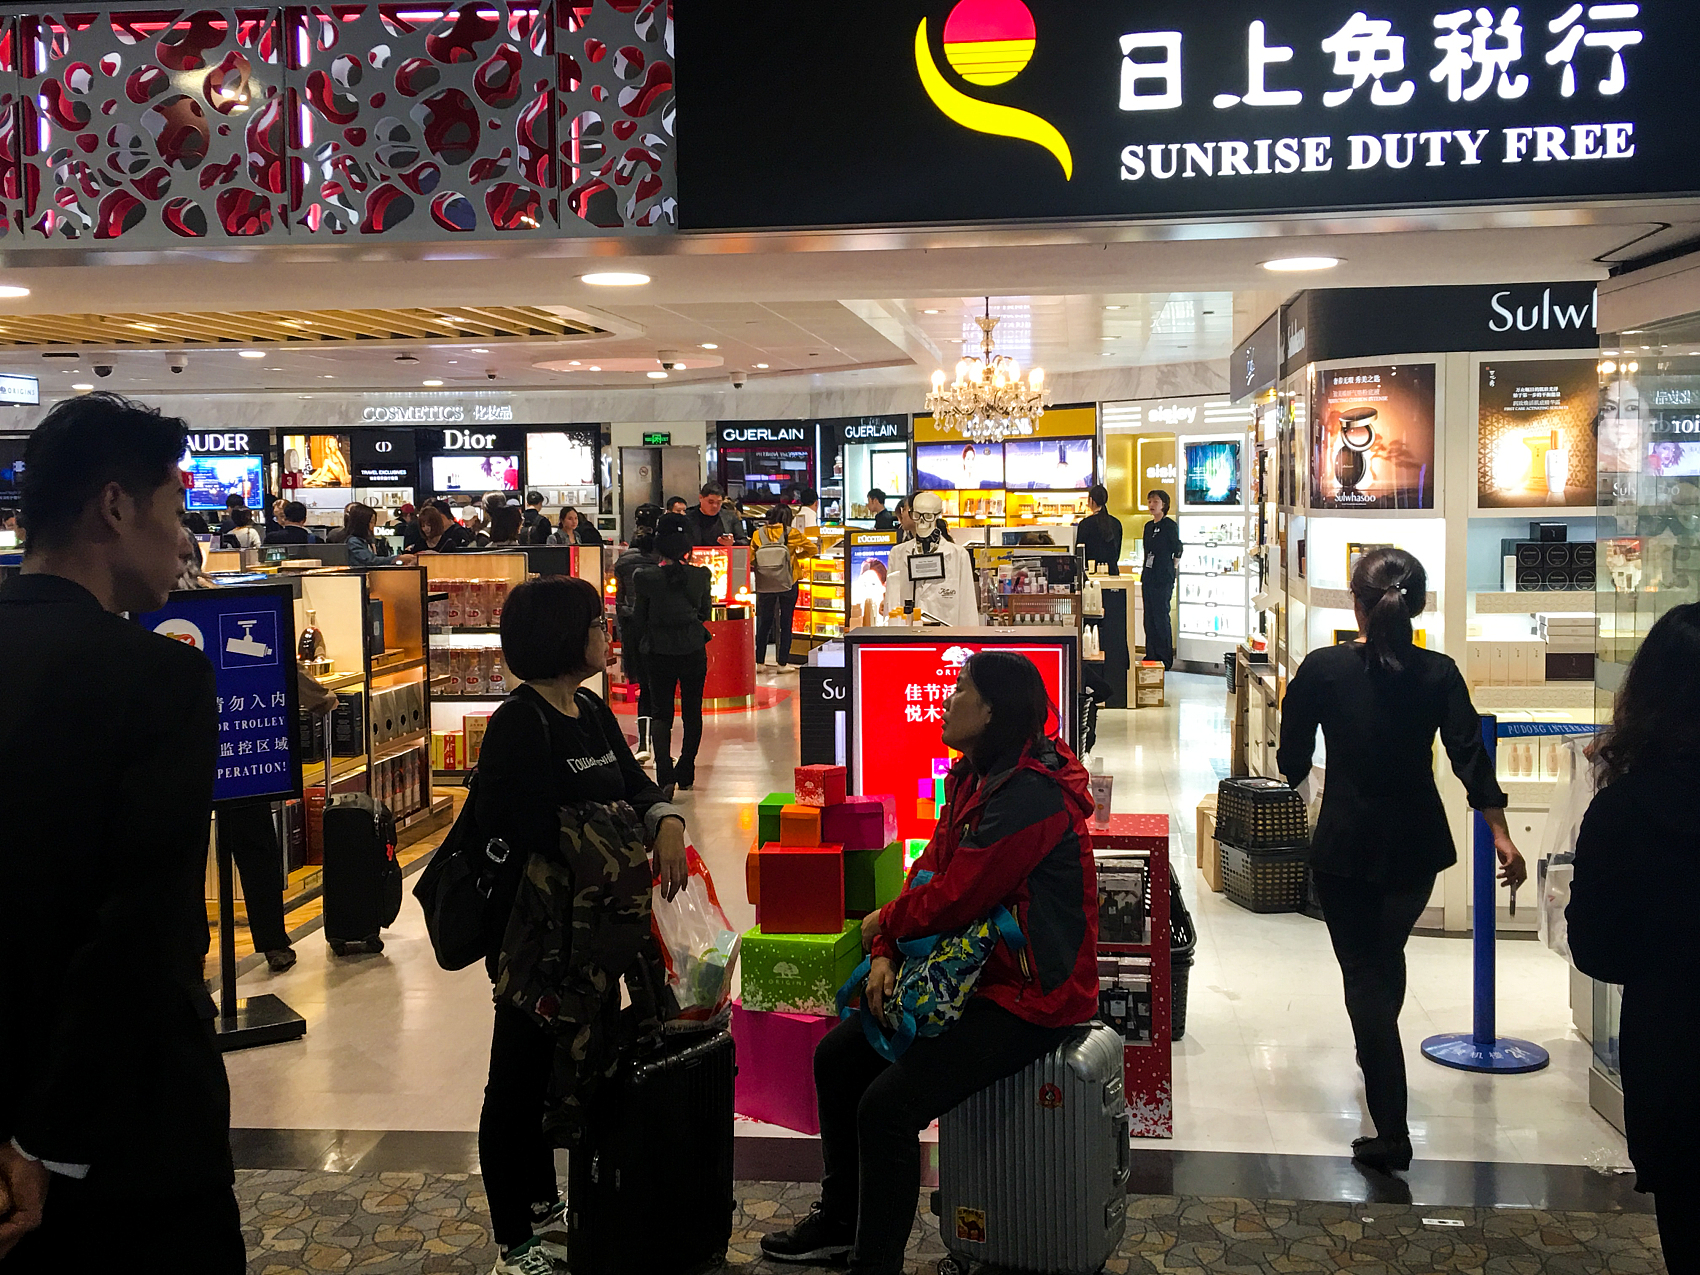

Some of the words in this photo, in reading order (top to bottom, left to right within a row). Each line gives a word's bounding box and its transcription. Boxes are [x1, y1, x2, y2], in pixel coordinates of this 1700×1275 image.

[1118, 3, 1644, 112] 日上免税行
[1119, 136, 1333, 182] SUNRISE
[1347, 129, 1489, 171] DUTY
[1502, 122, 1636, 162] FREE
[363, 405, 465, 422] COSMETICS
[473, 404, 513, 421] 化妆品
[723, 428, 804, 441] GUERLAIN
[845, 424, 898, 438] GUERLAIN
[443, 429, 497, 449] Dior
[287, 477, 293, 486] 3
[1335, 491, 1376, 502] Sulwhasoo
[374, 526, 395, 535] Dior
[905, 704, 946, 722] 悦木
[234, 716, 285, 730] TROLLEY
[1508, 725, 1546, 734] PUDONG
[220, 737, 288, 757] 监控区域
